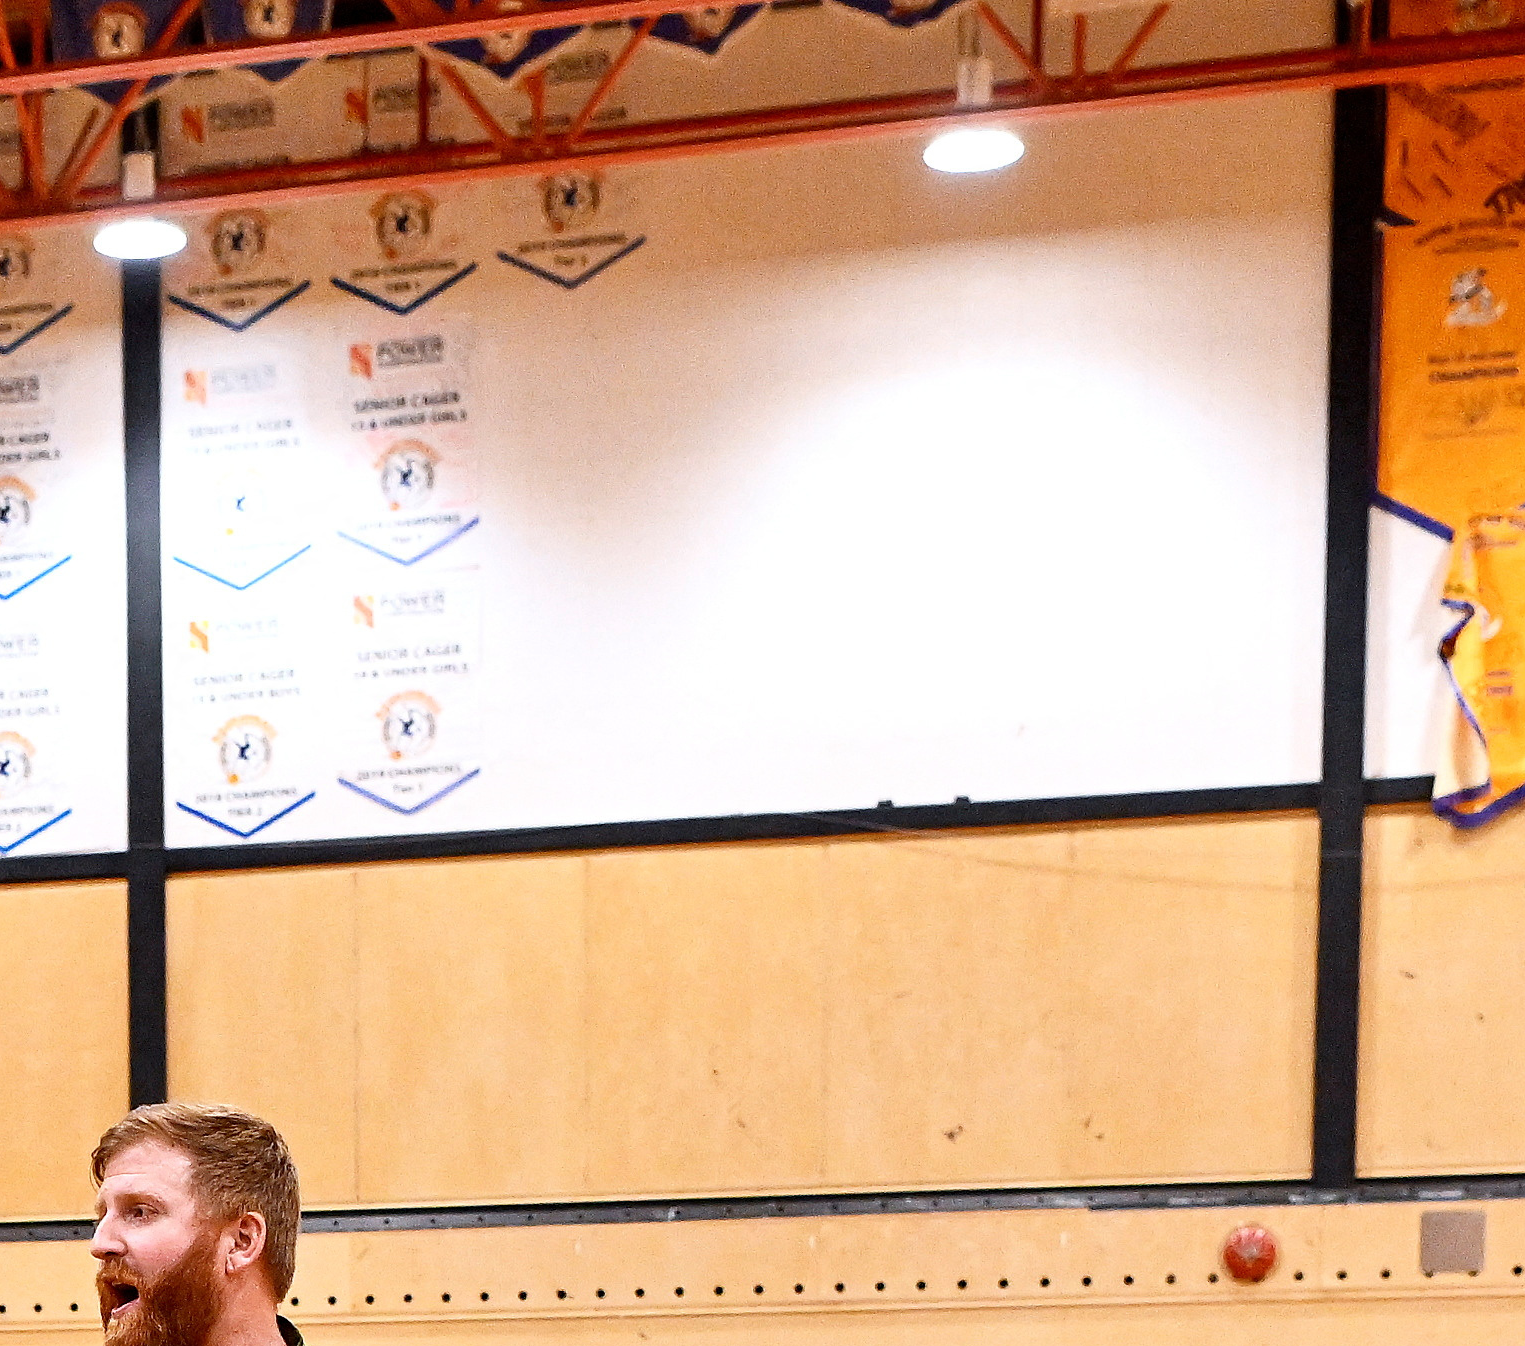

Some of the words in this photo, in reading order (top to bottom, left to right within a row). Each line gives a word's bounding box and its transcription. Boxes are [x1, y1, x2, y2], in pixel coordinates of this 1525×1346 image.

[377, 336, 443, 357] POWER
[354, 397, 406, 414] SENIOR
[410, 390, 461, 407] CAGER
[380, 590, 445, 608] POWER
[357, 648, 408, 664] SENIOR
[414, 642, 461, 659] CAGER
[10, 688, 49, 700] CAGER
